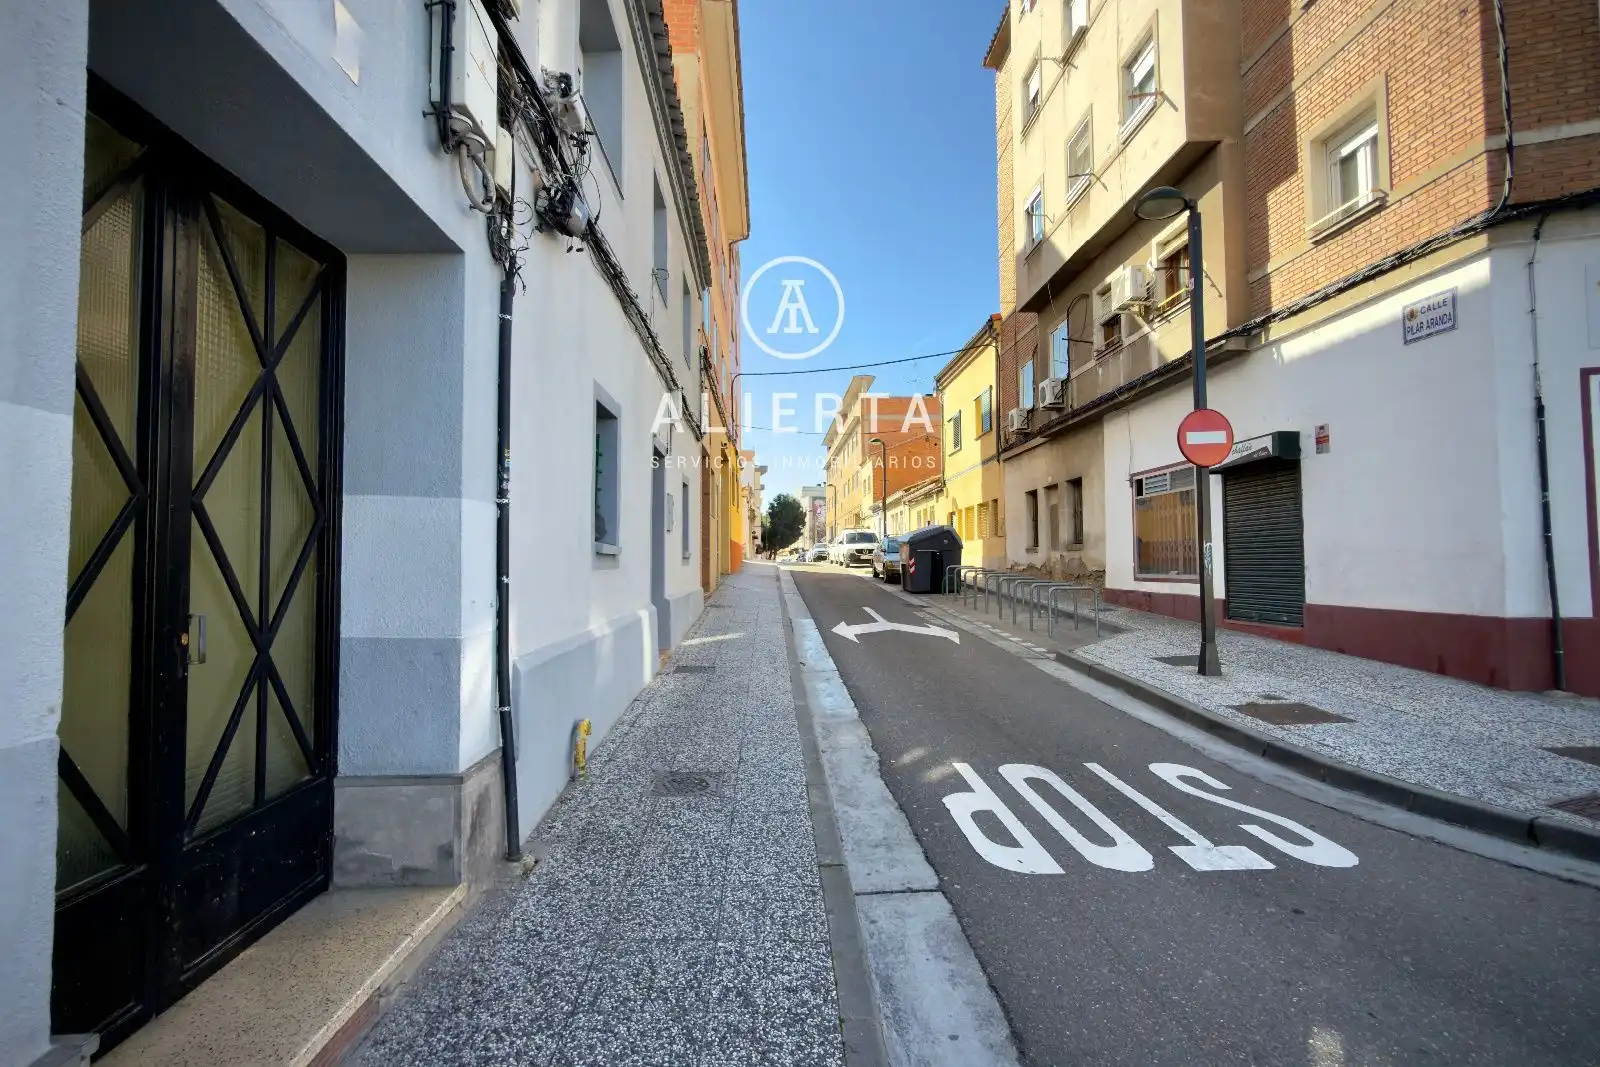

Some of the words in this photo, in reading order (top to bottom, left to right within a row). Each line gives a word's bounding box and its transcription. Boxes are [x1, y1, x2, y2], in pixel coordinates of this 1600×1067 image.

[1420, 298, 1448, 314] CALLE
[1406, 321, 1424, 336] PILAR
[1425, 311, 1453, 330] ARANDA
[942, 762, 1360, 875] STOP
